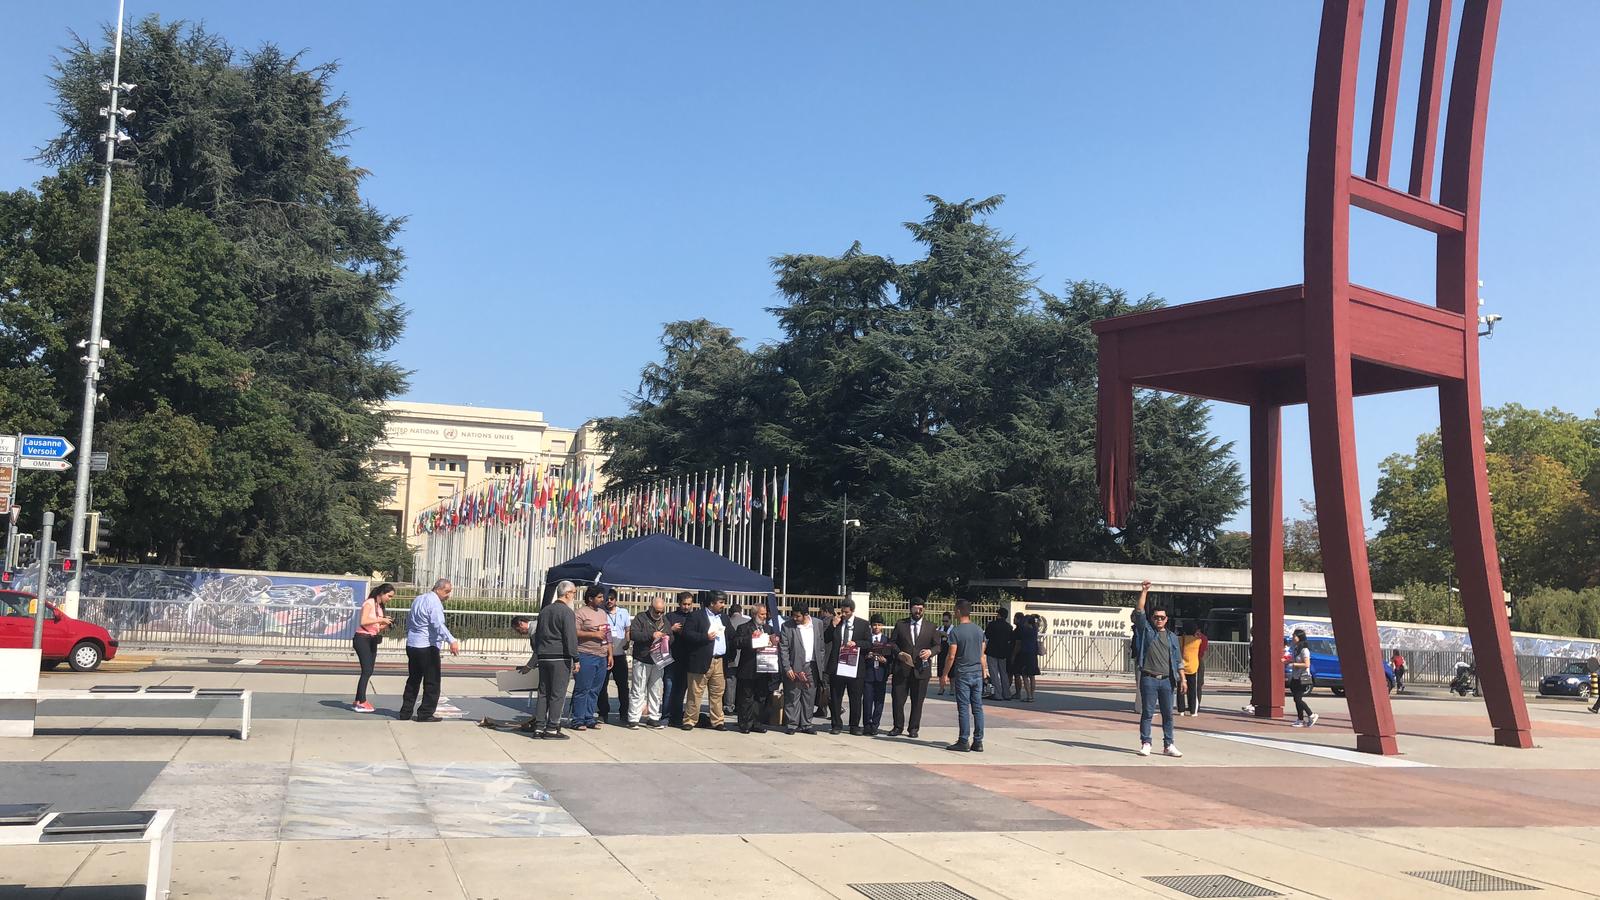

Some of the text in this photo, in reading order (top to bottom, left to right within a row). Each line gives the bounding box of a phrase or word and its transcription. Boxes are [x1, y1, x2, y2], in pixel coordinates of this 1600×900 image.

[410, 427, 439, 435] NATIONS
[461, 431, 492, 439] NATIONS
[494, 433, 514, 441] UNIES
[24, 438, 62, 447] Lausanne
[28, 447, 57, 455] Versoix
[1053, 618, 1126, 630] NATIONS UNIES
